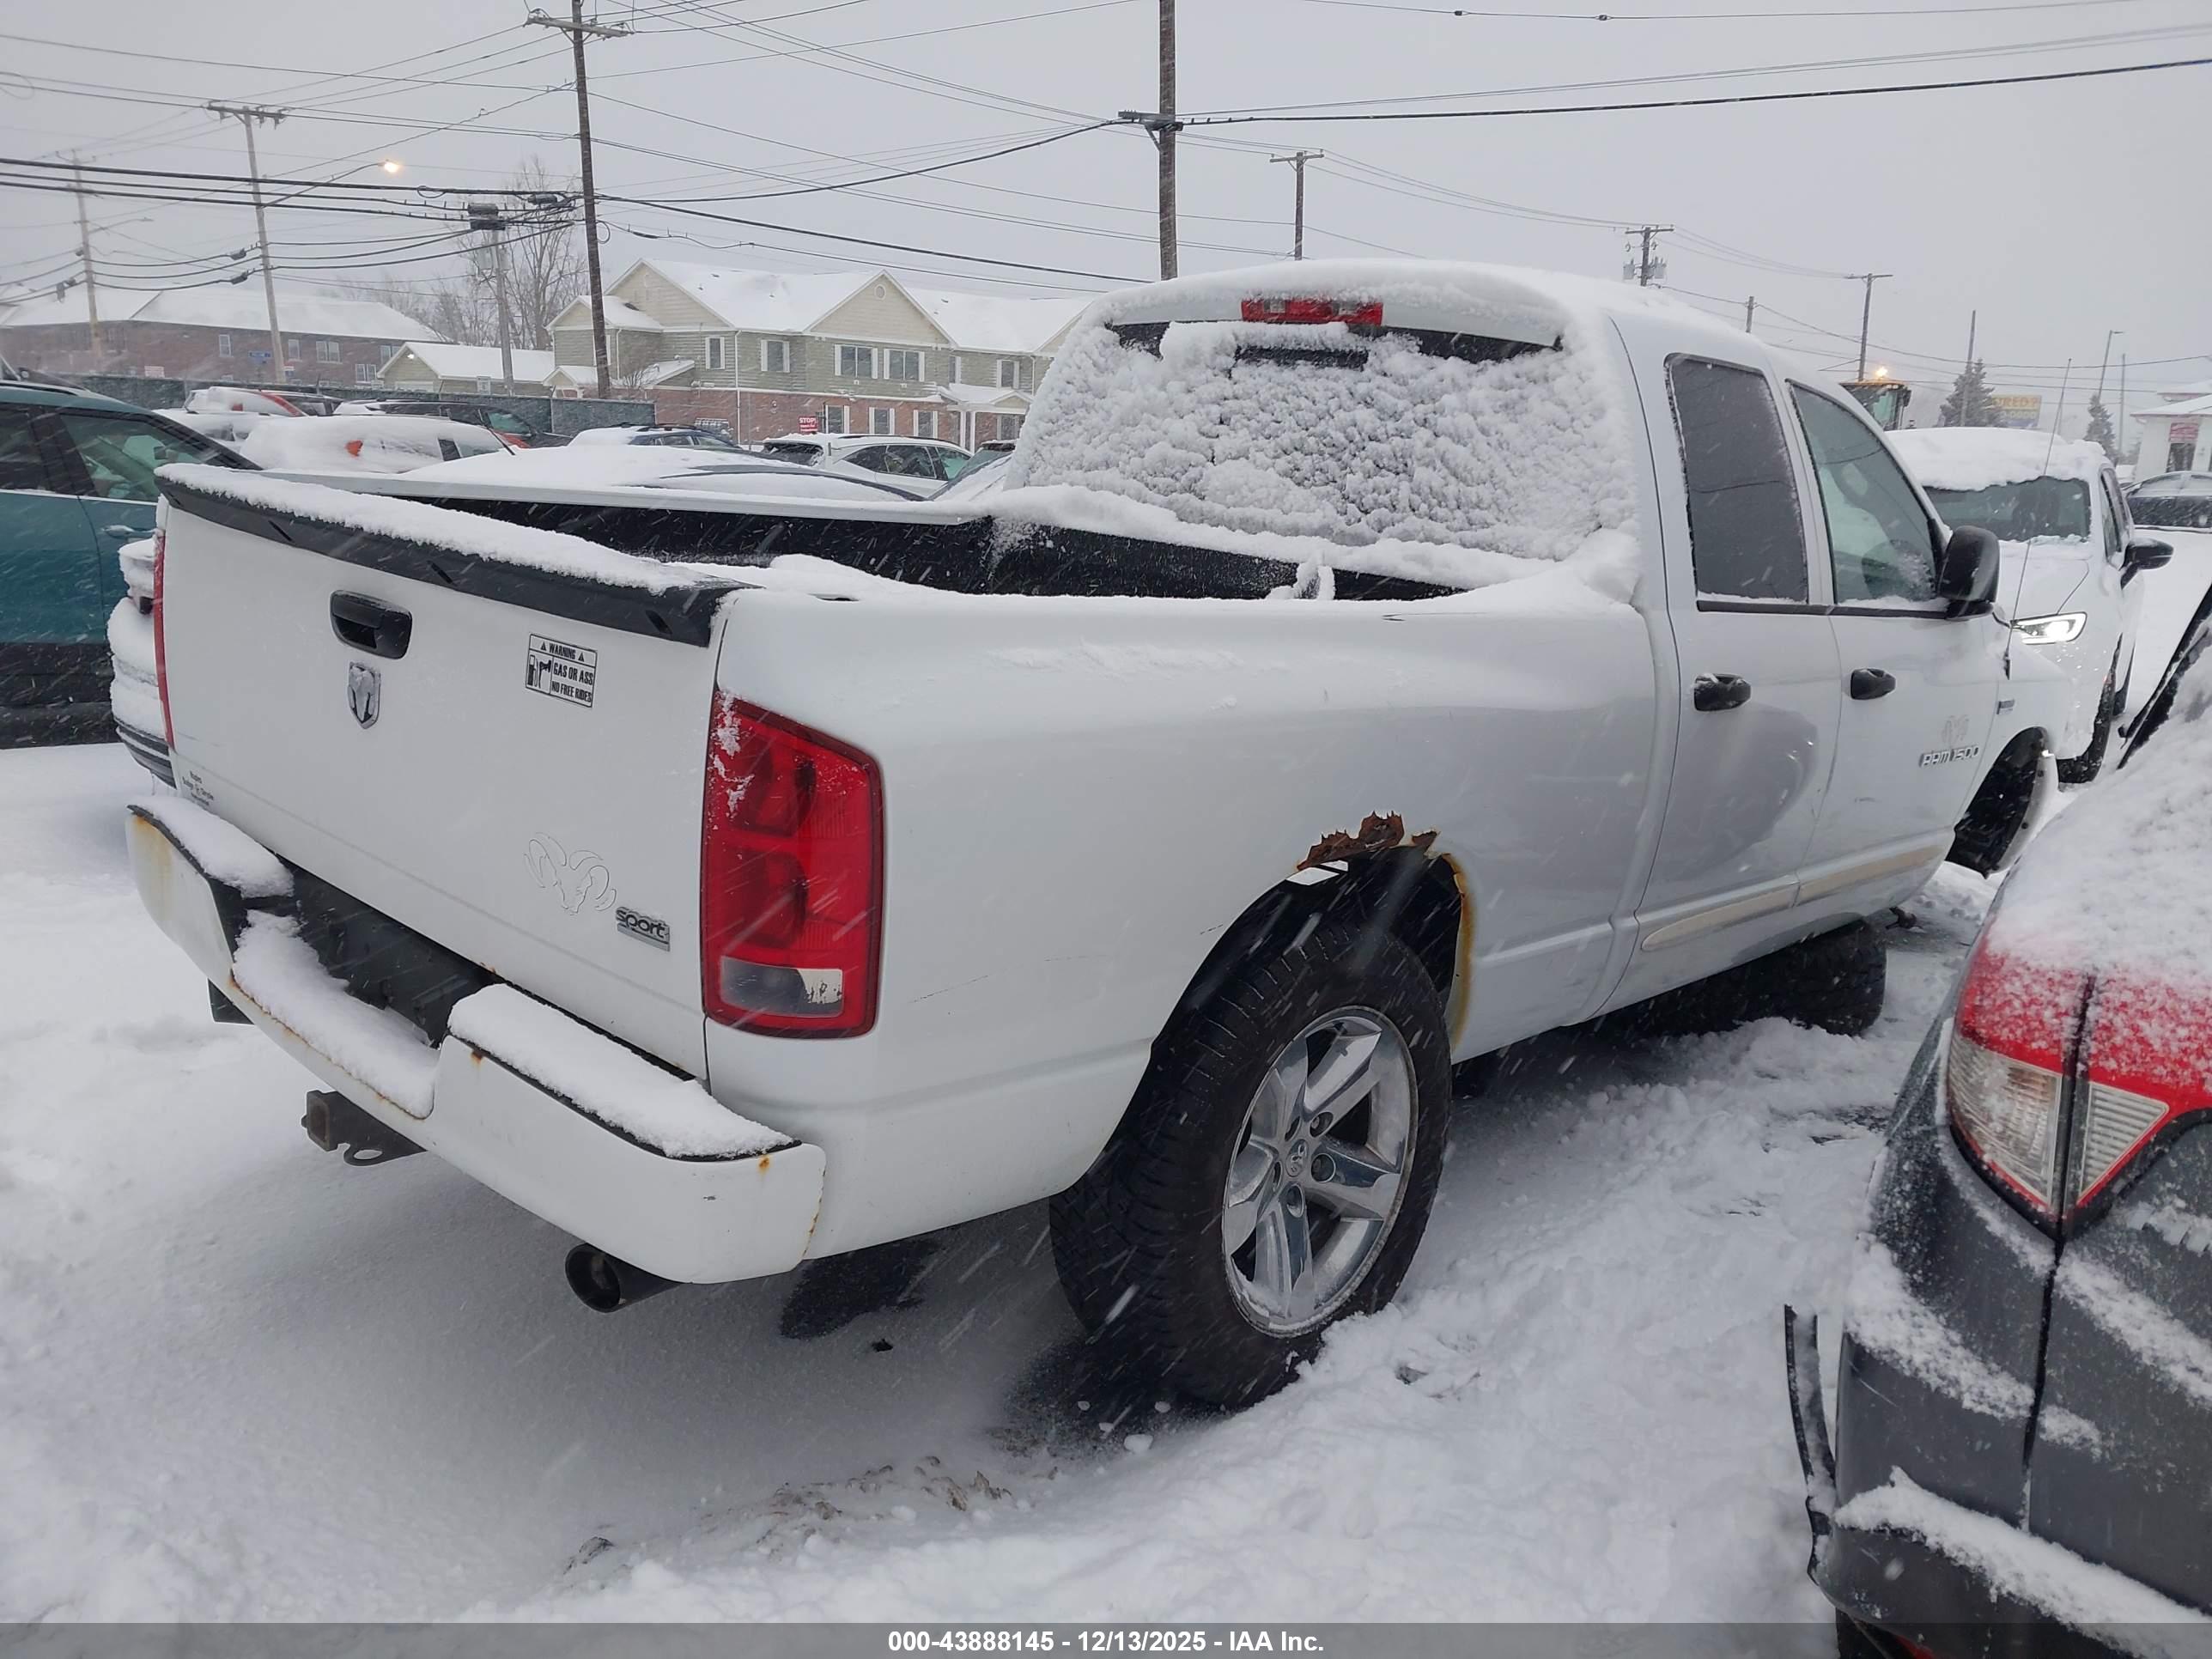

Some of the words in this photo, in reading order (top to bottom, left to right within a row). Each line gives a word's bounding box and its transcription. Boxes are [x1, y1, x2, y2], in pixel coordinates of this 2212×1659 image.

[550, 642, 576, 659] WARNING
[553, 662, 567, 678] GAS
[568, 666, 578, 681] OR
[579, 670, 593, 686] ASS
[551, 681, 560, 693] NO
[560, 683, 574, 698] FREE
[574, 688, 592, 703] RIDES
[1949, 745, 1979, 763] 1500
